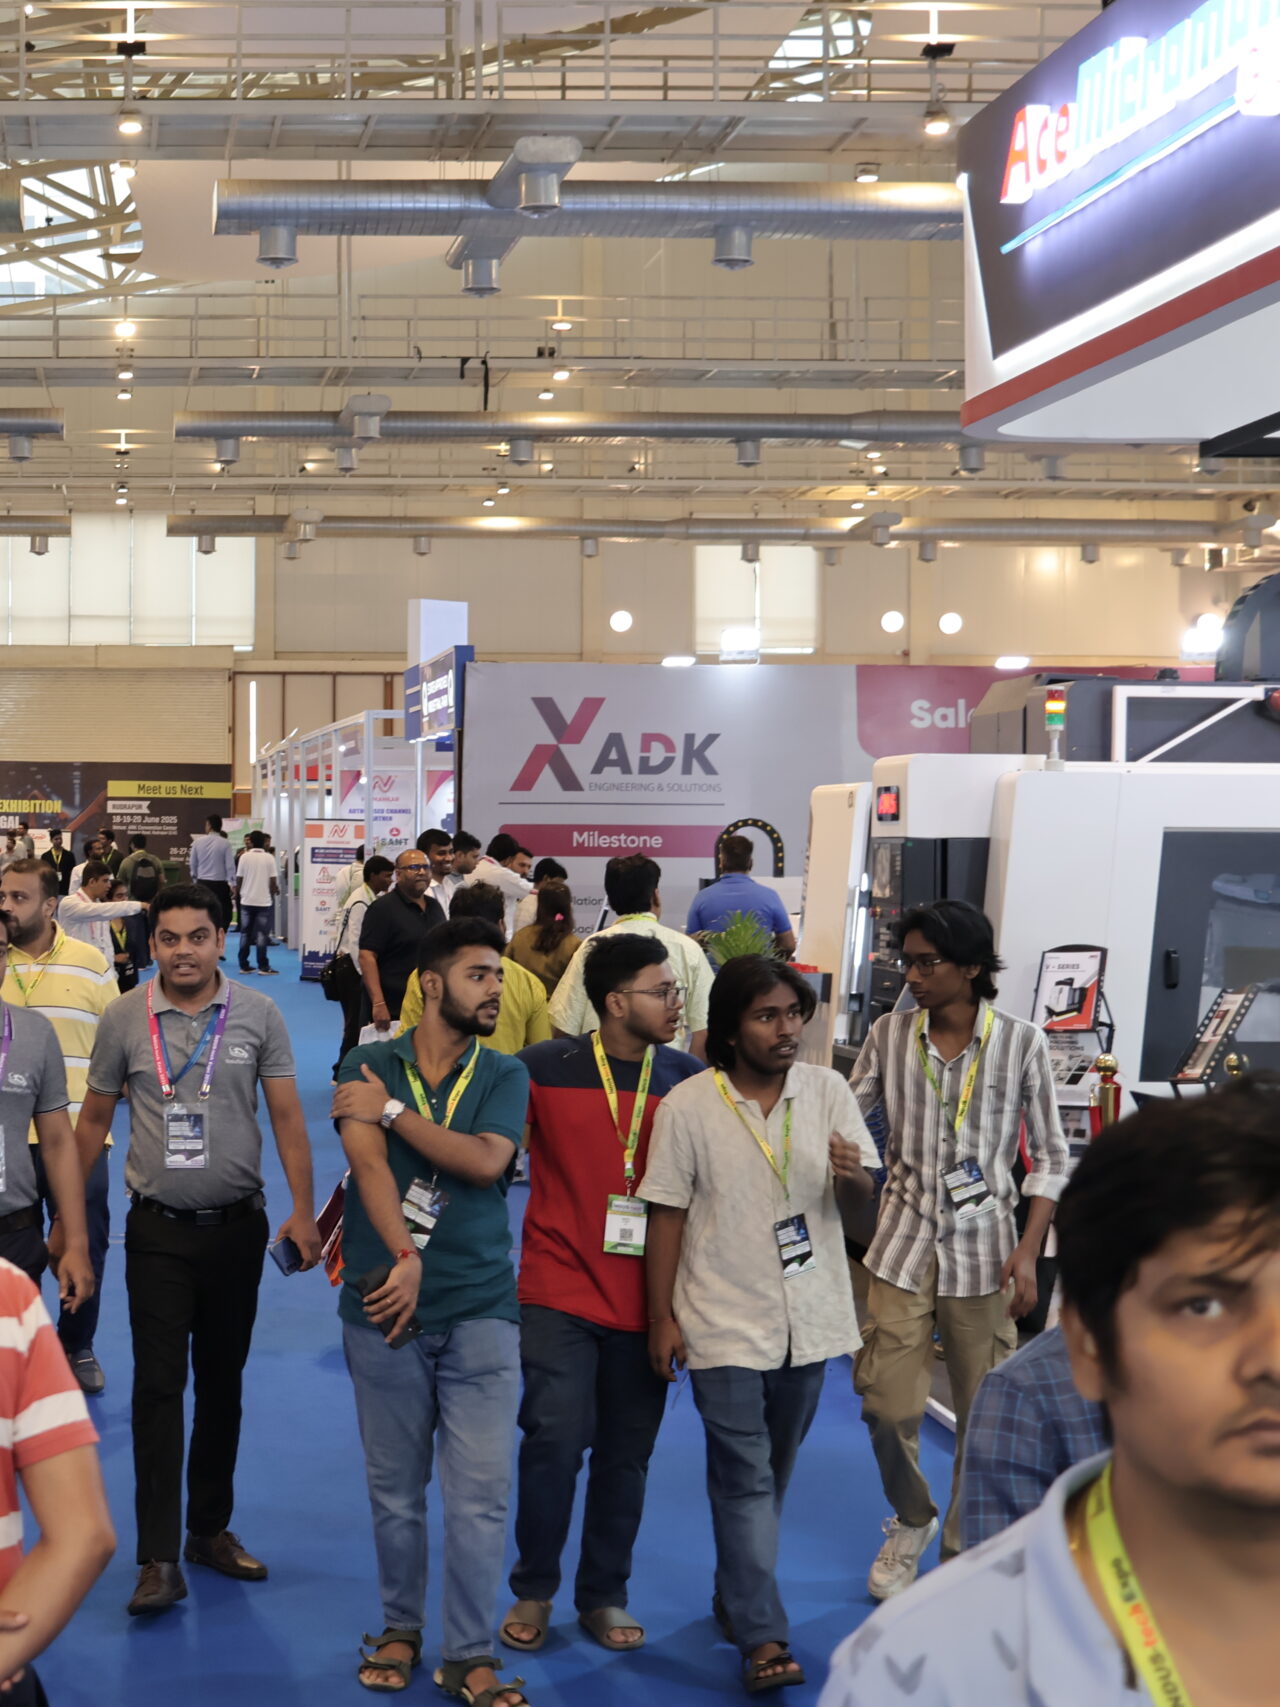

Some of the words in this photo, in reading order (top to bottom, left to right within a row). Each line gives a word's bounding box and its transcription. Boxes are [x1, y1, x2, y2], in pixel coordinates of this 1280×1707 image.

[910, 698, 975, 729] Sal
[590, 732, 721, 776] ADK
[137, 784, 161, 796] Meet
[165, 786, 177, 796] us
[181, 785, 204, 796] Next
[589, 782, 656, 793] ENGINEERING
[658, 783, 664, 792] &
[666, 782, 723, 793] SOLUTIONS
[573, 831, 663, 848] Milestone
